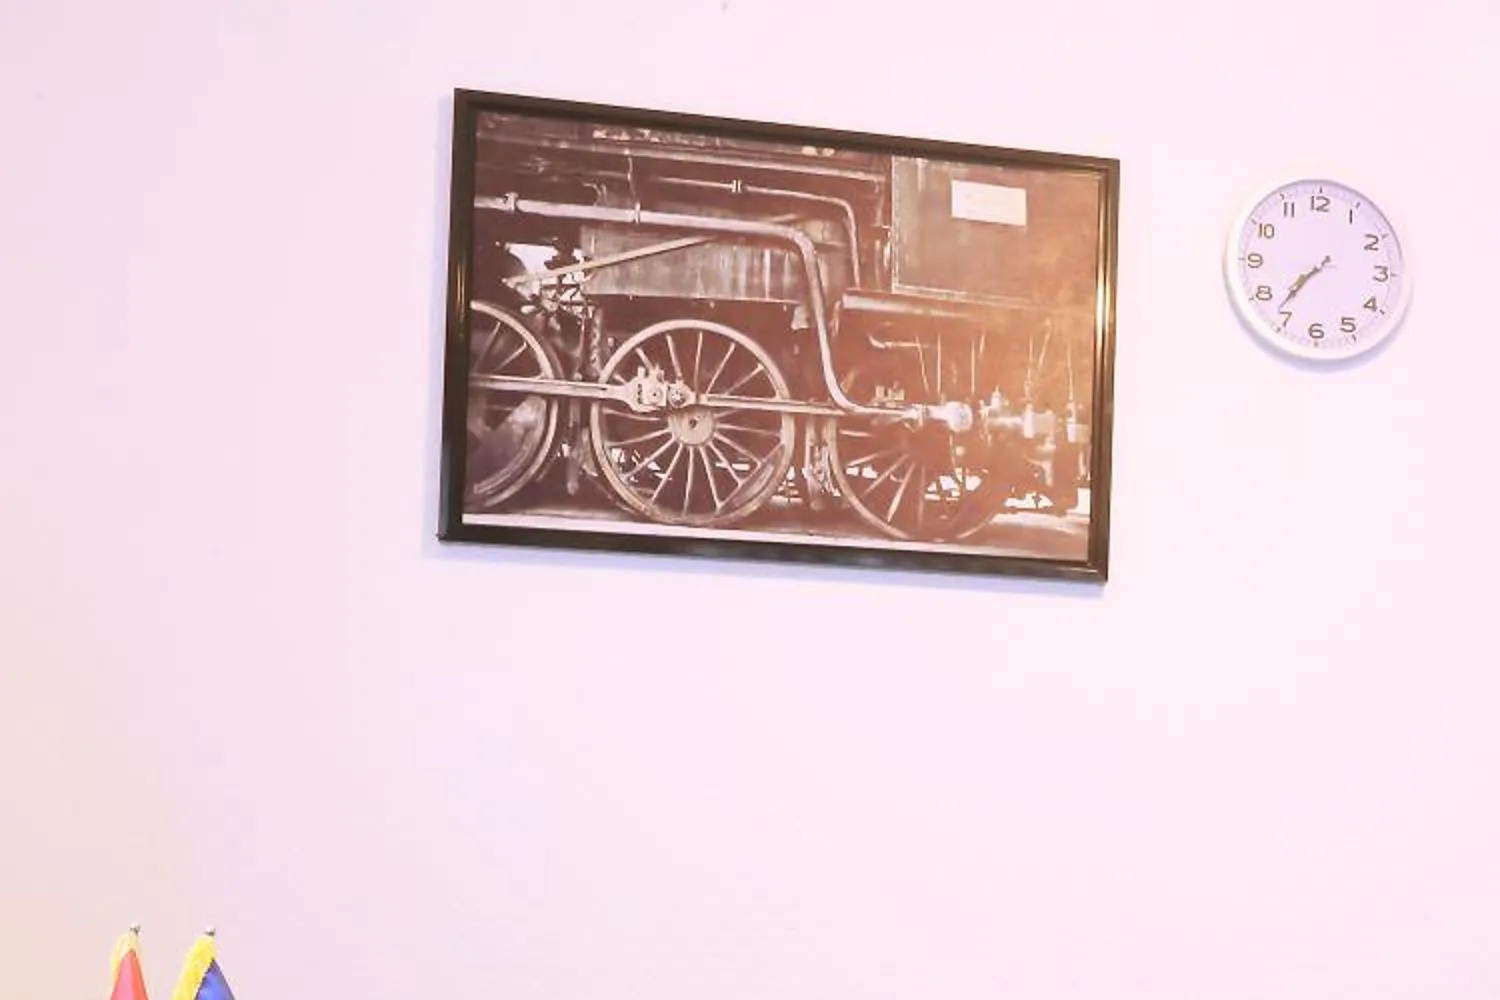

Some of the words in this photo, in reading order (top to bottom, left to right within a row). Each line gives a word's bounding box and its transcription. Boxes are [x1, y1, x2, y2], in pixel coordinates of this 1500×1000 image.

[1283, 202, 1295, 218] 11
[1310, 195, 1331, 213] 12
[1257, 223, 1275, 239] 10
[1363, 233, 1380, 251] 2
[1247, 253, 1264, 269] 9
[1372, 265, 1389, 282] 3
[1255, 285, 1273, 301] 8
[1362, 295, 1378, 313] 4
[1279, 311, 1293, 328] 7
[1340, 317, 1357, 333] 5
[1307, 323, 1325, 339] 6
